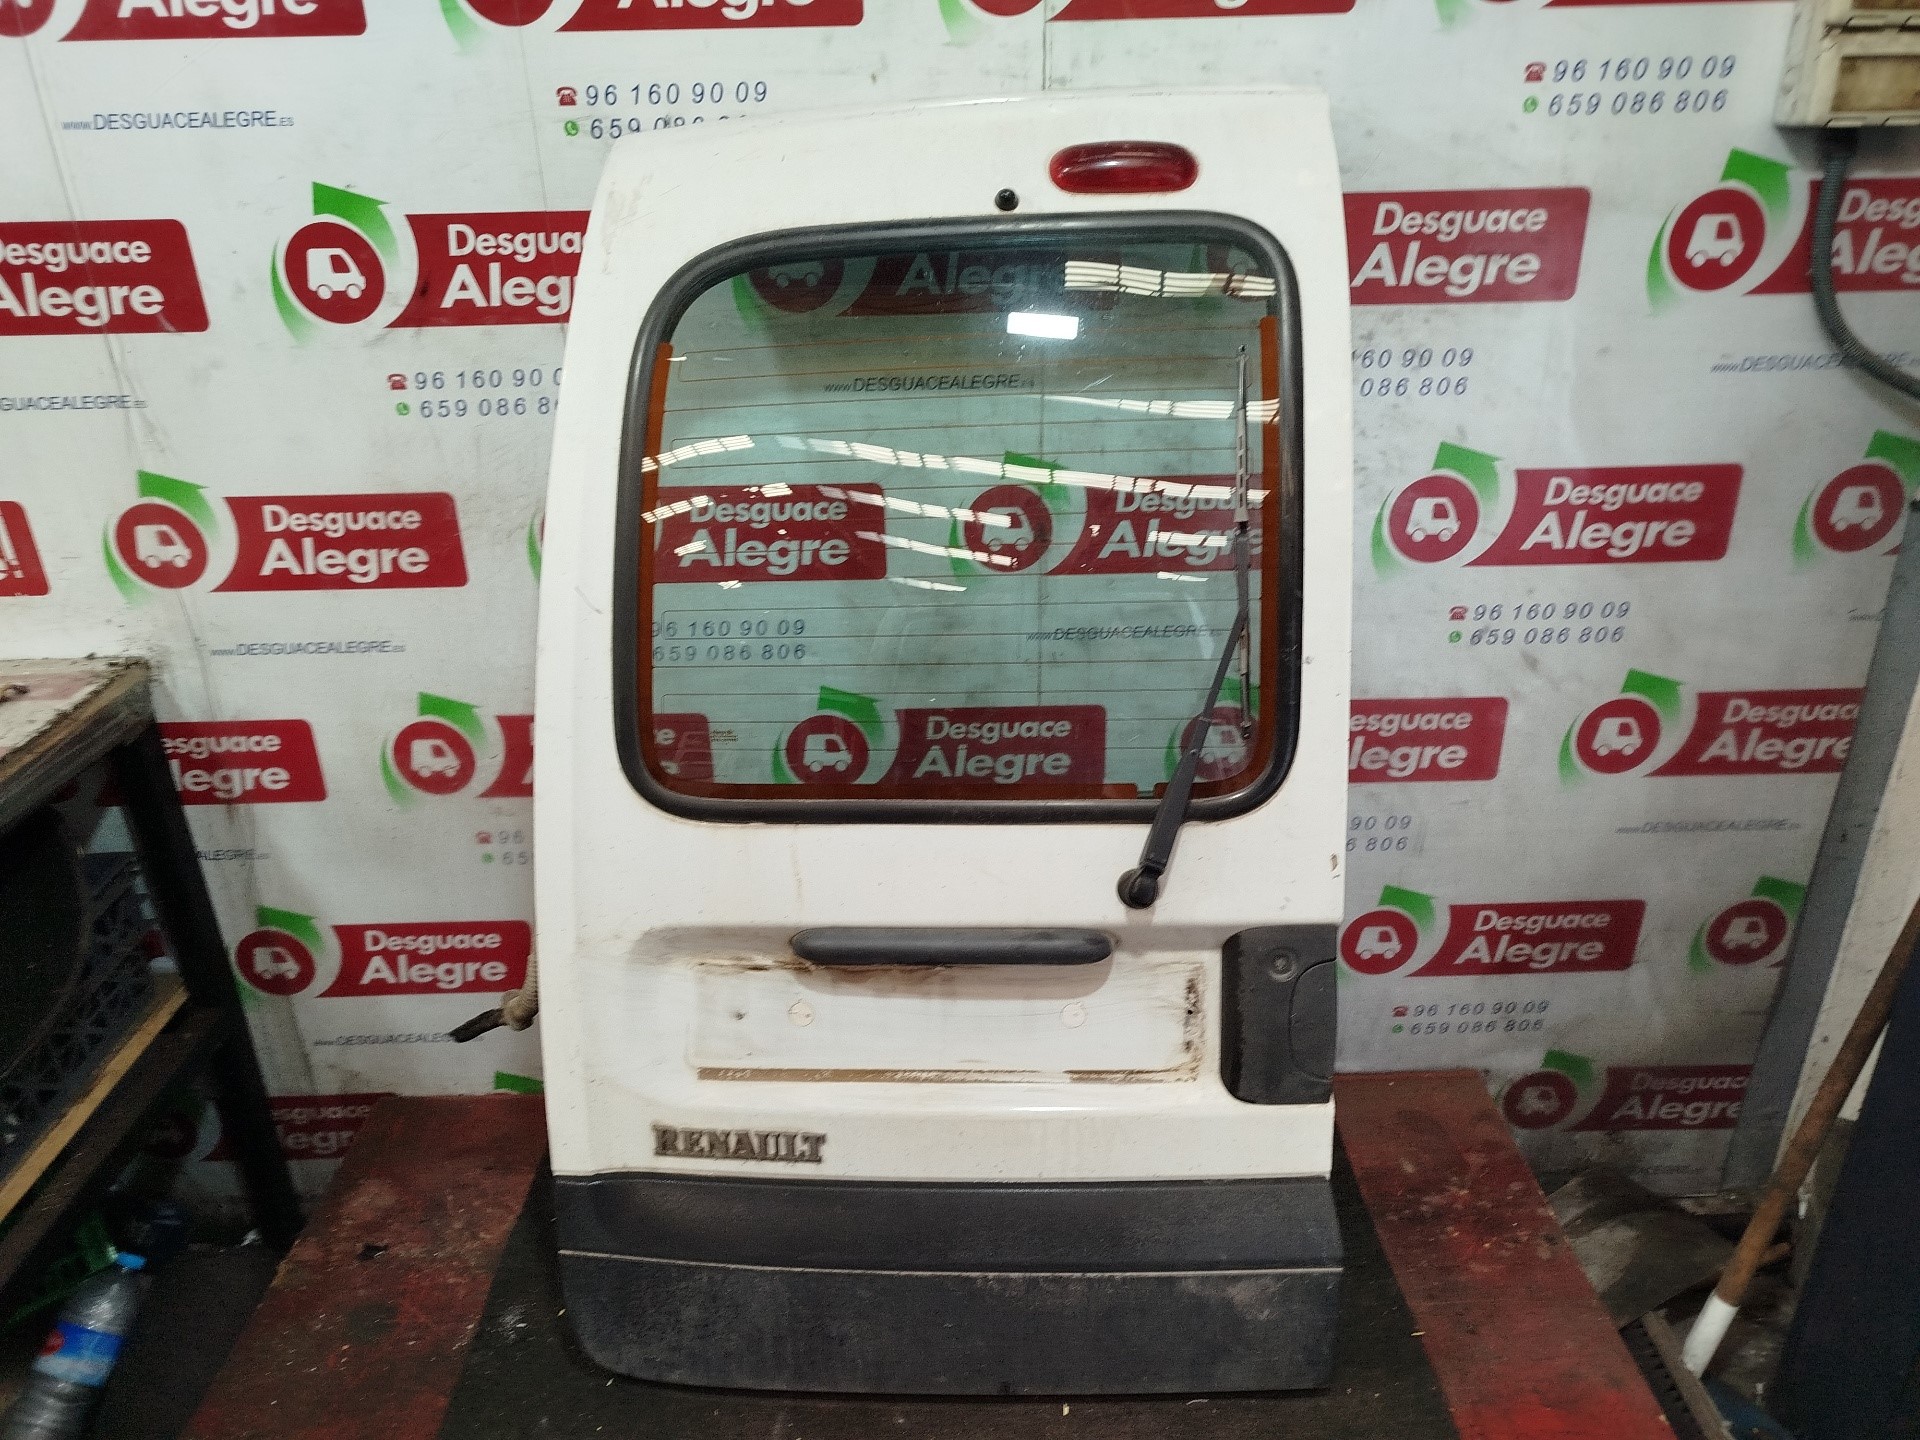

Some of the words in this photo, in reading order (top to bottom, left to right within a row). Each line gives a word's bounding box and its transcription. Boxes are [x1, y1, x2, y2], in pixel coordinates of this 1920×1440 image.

[1553, 59, 1587, 83] 96
[1600, 57, 1650, 81] 160
[1658, 56, 1693, 80] 90
[1701, 55, 1736, 79] 09
[586, 84, 617, 106] 96
[631, 83, 680, 105] 160
[692, 82, 725, 104] 90
[736, 81, 767, 103] 09
[1548, 92, 1602, 117] 659
[1610, 90, 1666, 115] 086
[1674, 89, 1728, 113] 806
[590, 118, 641, 139] 659
[1372, 201, 1548, 242] Desguace
[0, 240, 151, 273] esguace
[447, 224, 583, 262] Desgua
[1350, 240, 1541, 297] Alegre
[440, 262, 577, 316] Aleg
[1402, 348, 1433, 367] 90
[1442, 347, 1474, 367] 09
[414, 371, 445, 390] 96
[456, 370, 502, 388] 160
[512, 368, 543, 387] 90
[1360, 377, 1410, 397] 086
[1419, 376, 1469, 396] 806
[420, 400, 467, 418] 659
[478, 398, 527, 416] 086
[537, 396, 559, 415] 8
[1543, 476, 1704, 512] Desguace
[261, 504, 422, 538] Desguace
[690, 496, 848, 529] Desguace
[1519, 509, 1696, 558] Alegre
[258, 537, 430, 584] Alegre
[678, 527, 850, 575] Alegre
[1473, 603, 1503, 621] 96
[1513, 602, 1557, 620] 160
[1563, 601, 1594, 619] 90
[1601, 600, 1631, 619] 09
[652, 621, 678, 637] 96
[688, 620, 731, 637] 160
[740, 619, 768, 636] 90
[777, 618, 805, 636] 09
[1470, 628, 1516, 646] 659
[1524, 627, 1570, 645] 086
[1578, 626, 1625, 643] 806
[653, 645, 697, 661] 659
[707, 644, 752, 661] 086
[762, 643, 806, 660] 806
[926, 715, 1072, 744] Desguace
[912, 744, 1072, 784] Alegre
[1351, 815, 1377, 831] 90
[1384, 814, 1412, 831] 09
[1365, 836, 1409, 851] 806
[1473, 909, 1612, 935] Desguace
[364, 929, 502, 955] Desguace
[1453, 934, 1604, 969] Alegre
[359, 954, 507, 990] Alegre
[1413, 1004, 1439, 1018] 96
[1447, 1002, 1485, 1017] 160
[1491, 1001, 1518, 1016] 90
[1522, 1000, 1550, 1015] 09
[1410, 1021, 1450, 1036] 659
[652, 1123, 827, 1164] RENAULT
